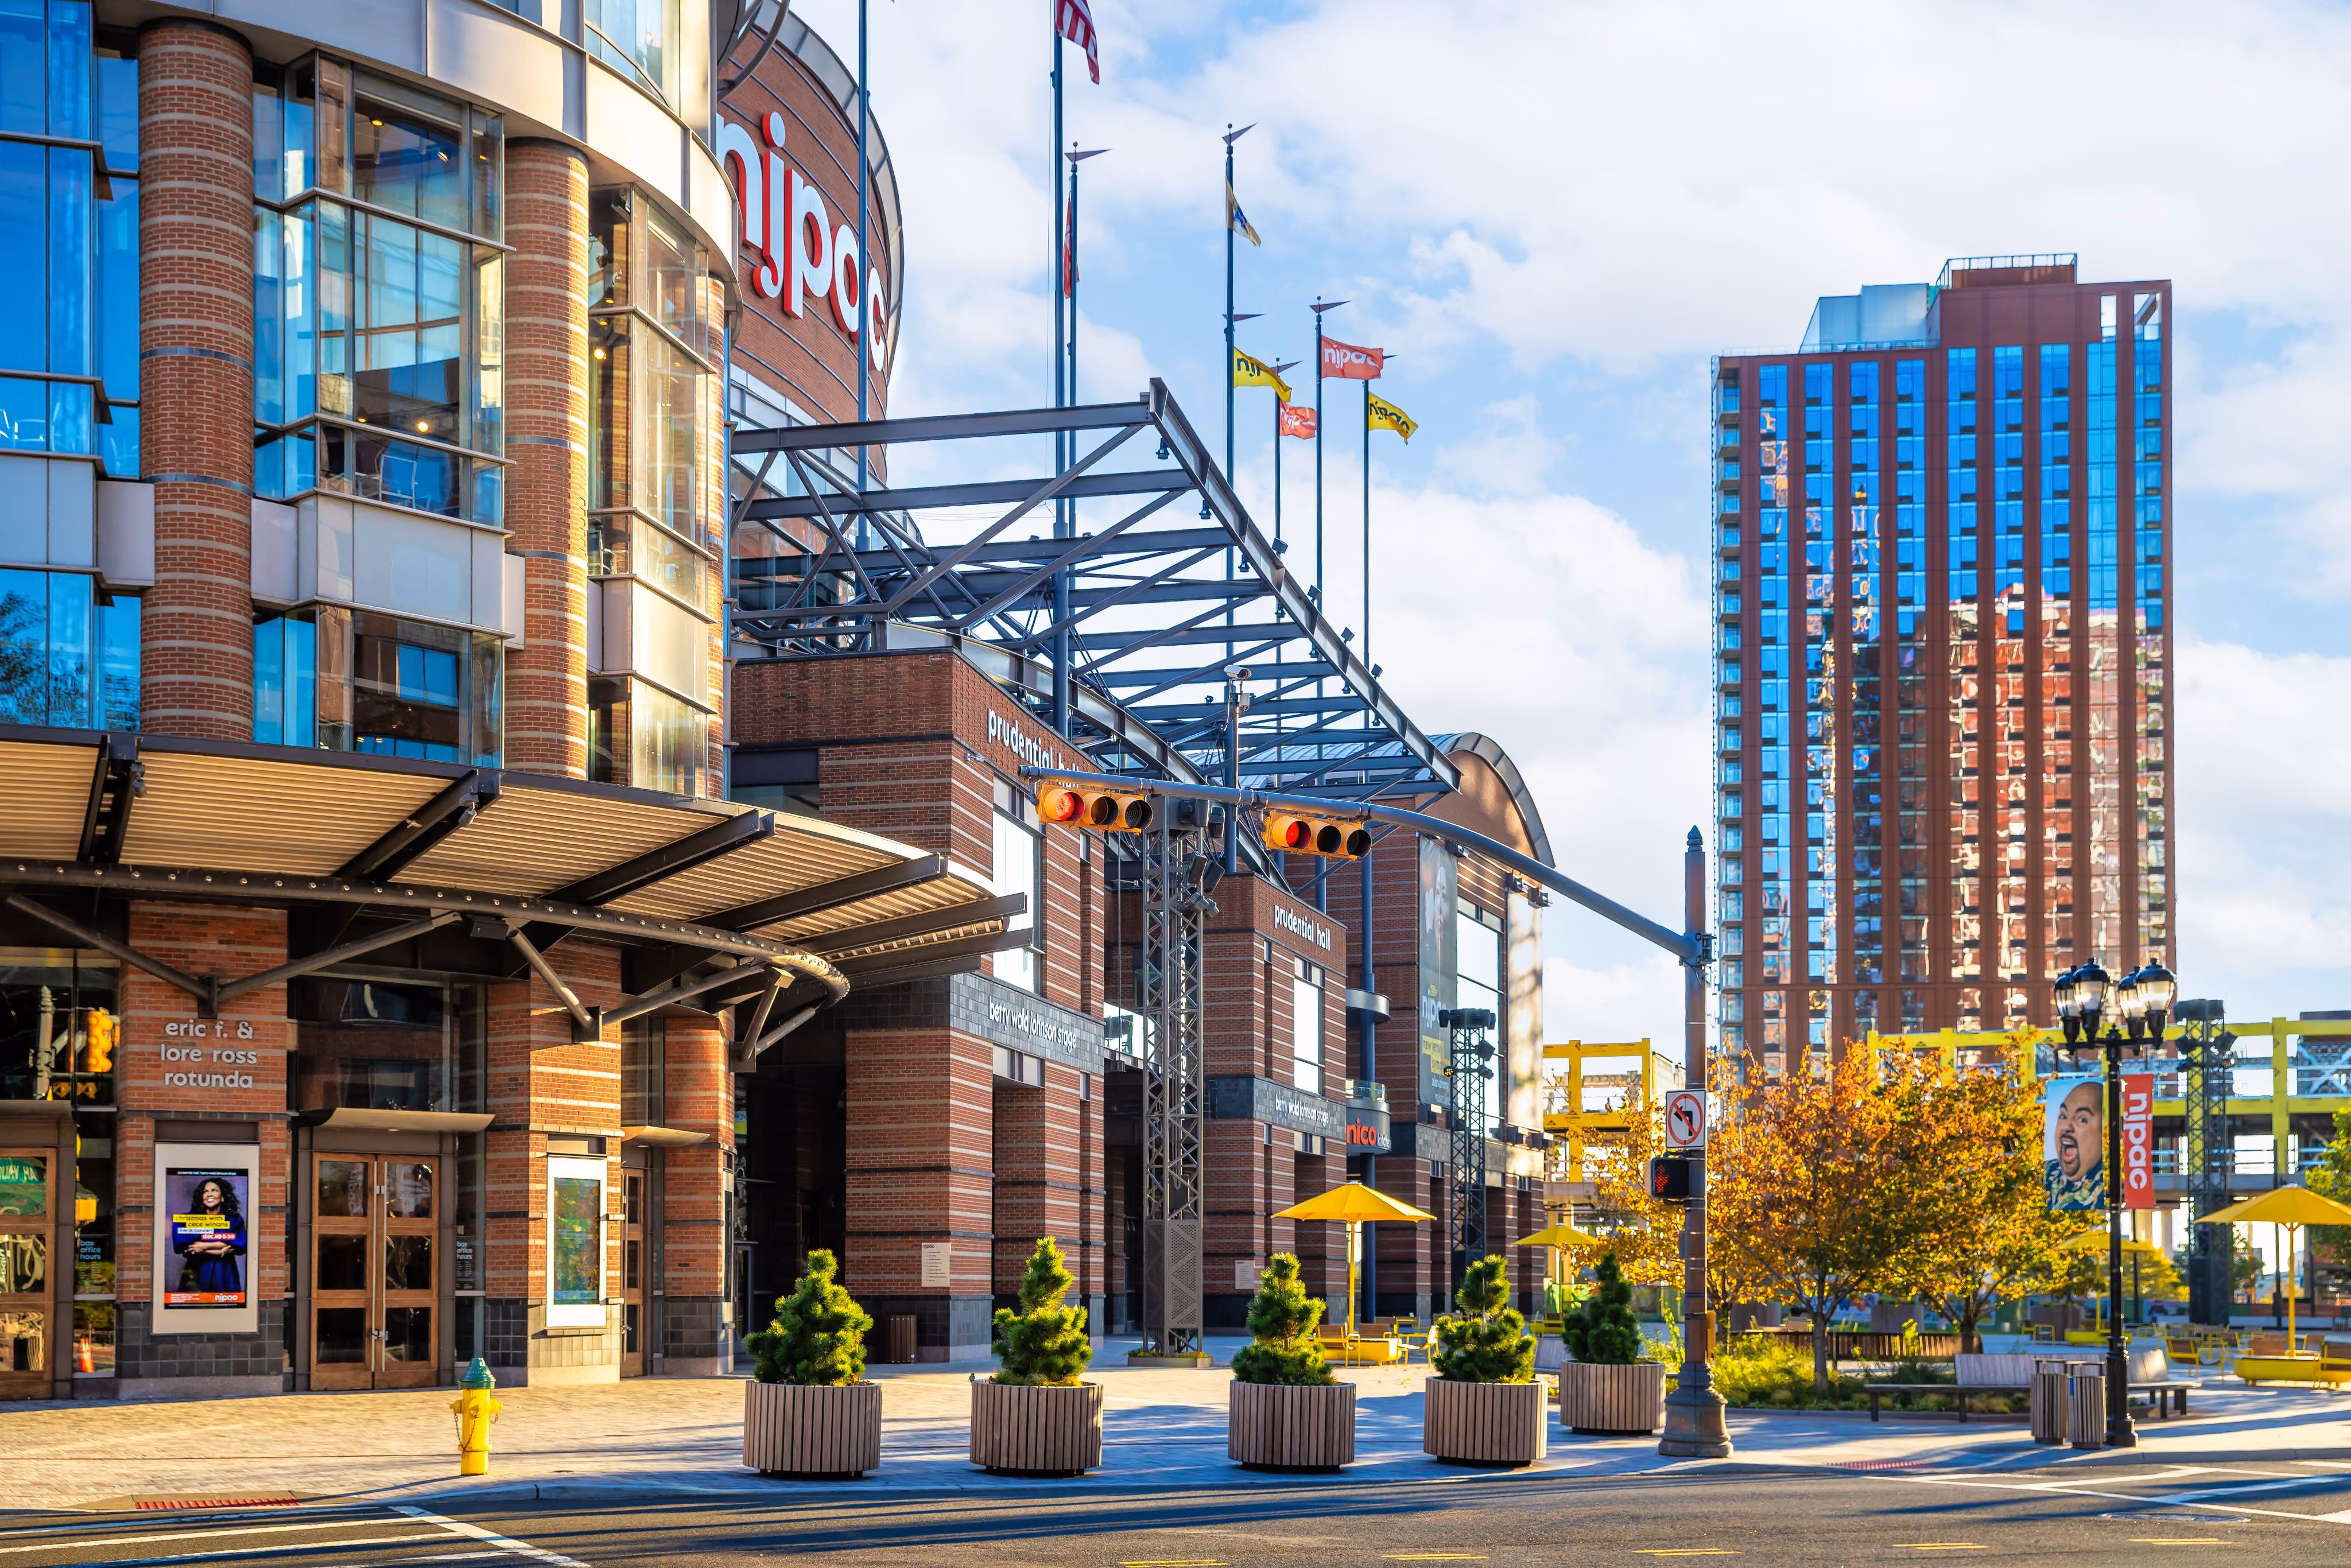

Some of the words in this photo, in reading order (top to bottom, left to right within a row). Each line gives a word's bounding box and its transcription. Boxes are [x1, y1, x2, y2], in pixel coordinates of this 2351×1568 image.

[716, 111, 886, 372] njpac
[988, 708, 1053, 769] prudential
[1274, 905, 1314, 942] prudential
[1317, 922, 1330, 952] hall
[165, 1019, 207, 1037] eric
[215, 1020, 228, 1038] f.
[236, 1021, 254, 1039] &
[988, 996, 1010, 1031] betty
[1011, 1008, 1029, 1033] wold
[1029, 1011, 1057, 1042] johnson
[1057, 1026, 1076, 1053] stage
[160, 1043, 203, 1062] lore
[212, 1049, 258, 1064] ross
[165, 1070, 253, 1089] rotunda
[1275, 1094, 1288, 1117] betty
[1288, 1100, 1299, 1116] wold
[1299, 1101, 1317, 1121] johnson
[1317, 1108, 1329, 1127] stage
[1346, 1117, 1377, 1146] nico
[2123, 1092, 2153, 1190] njpac
